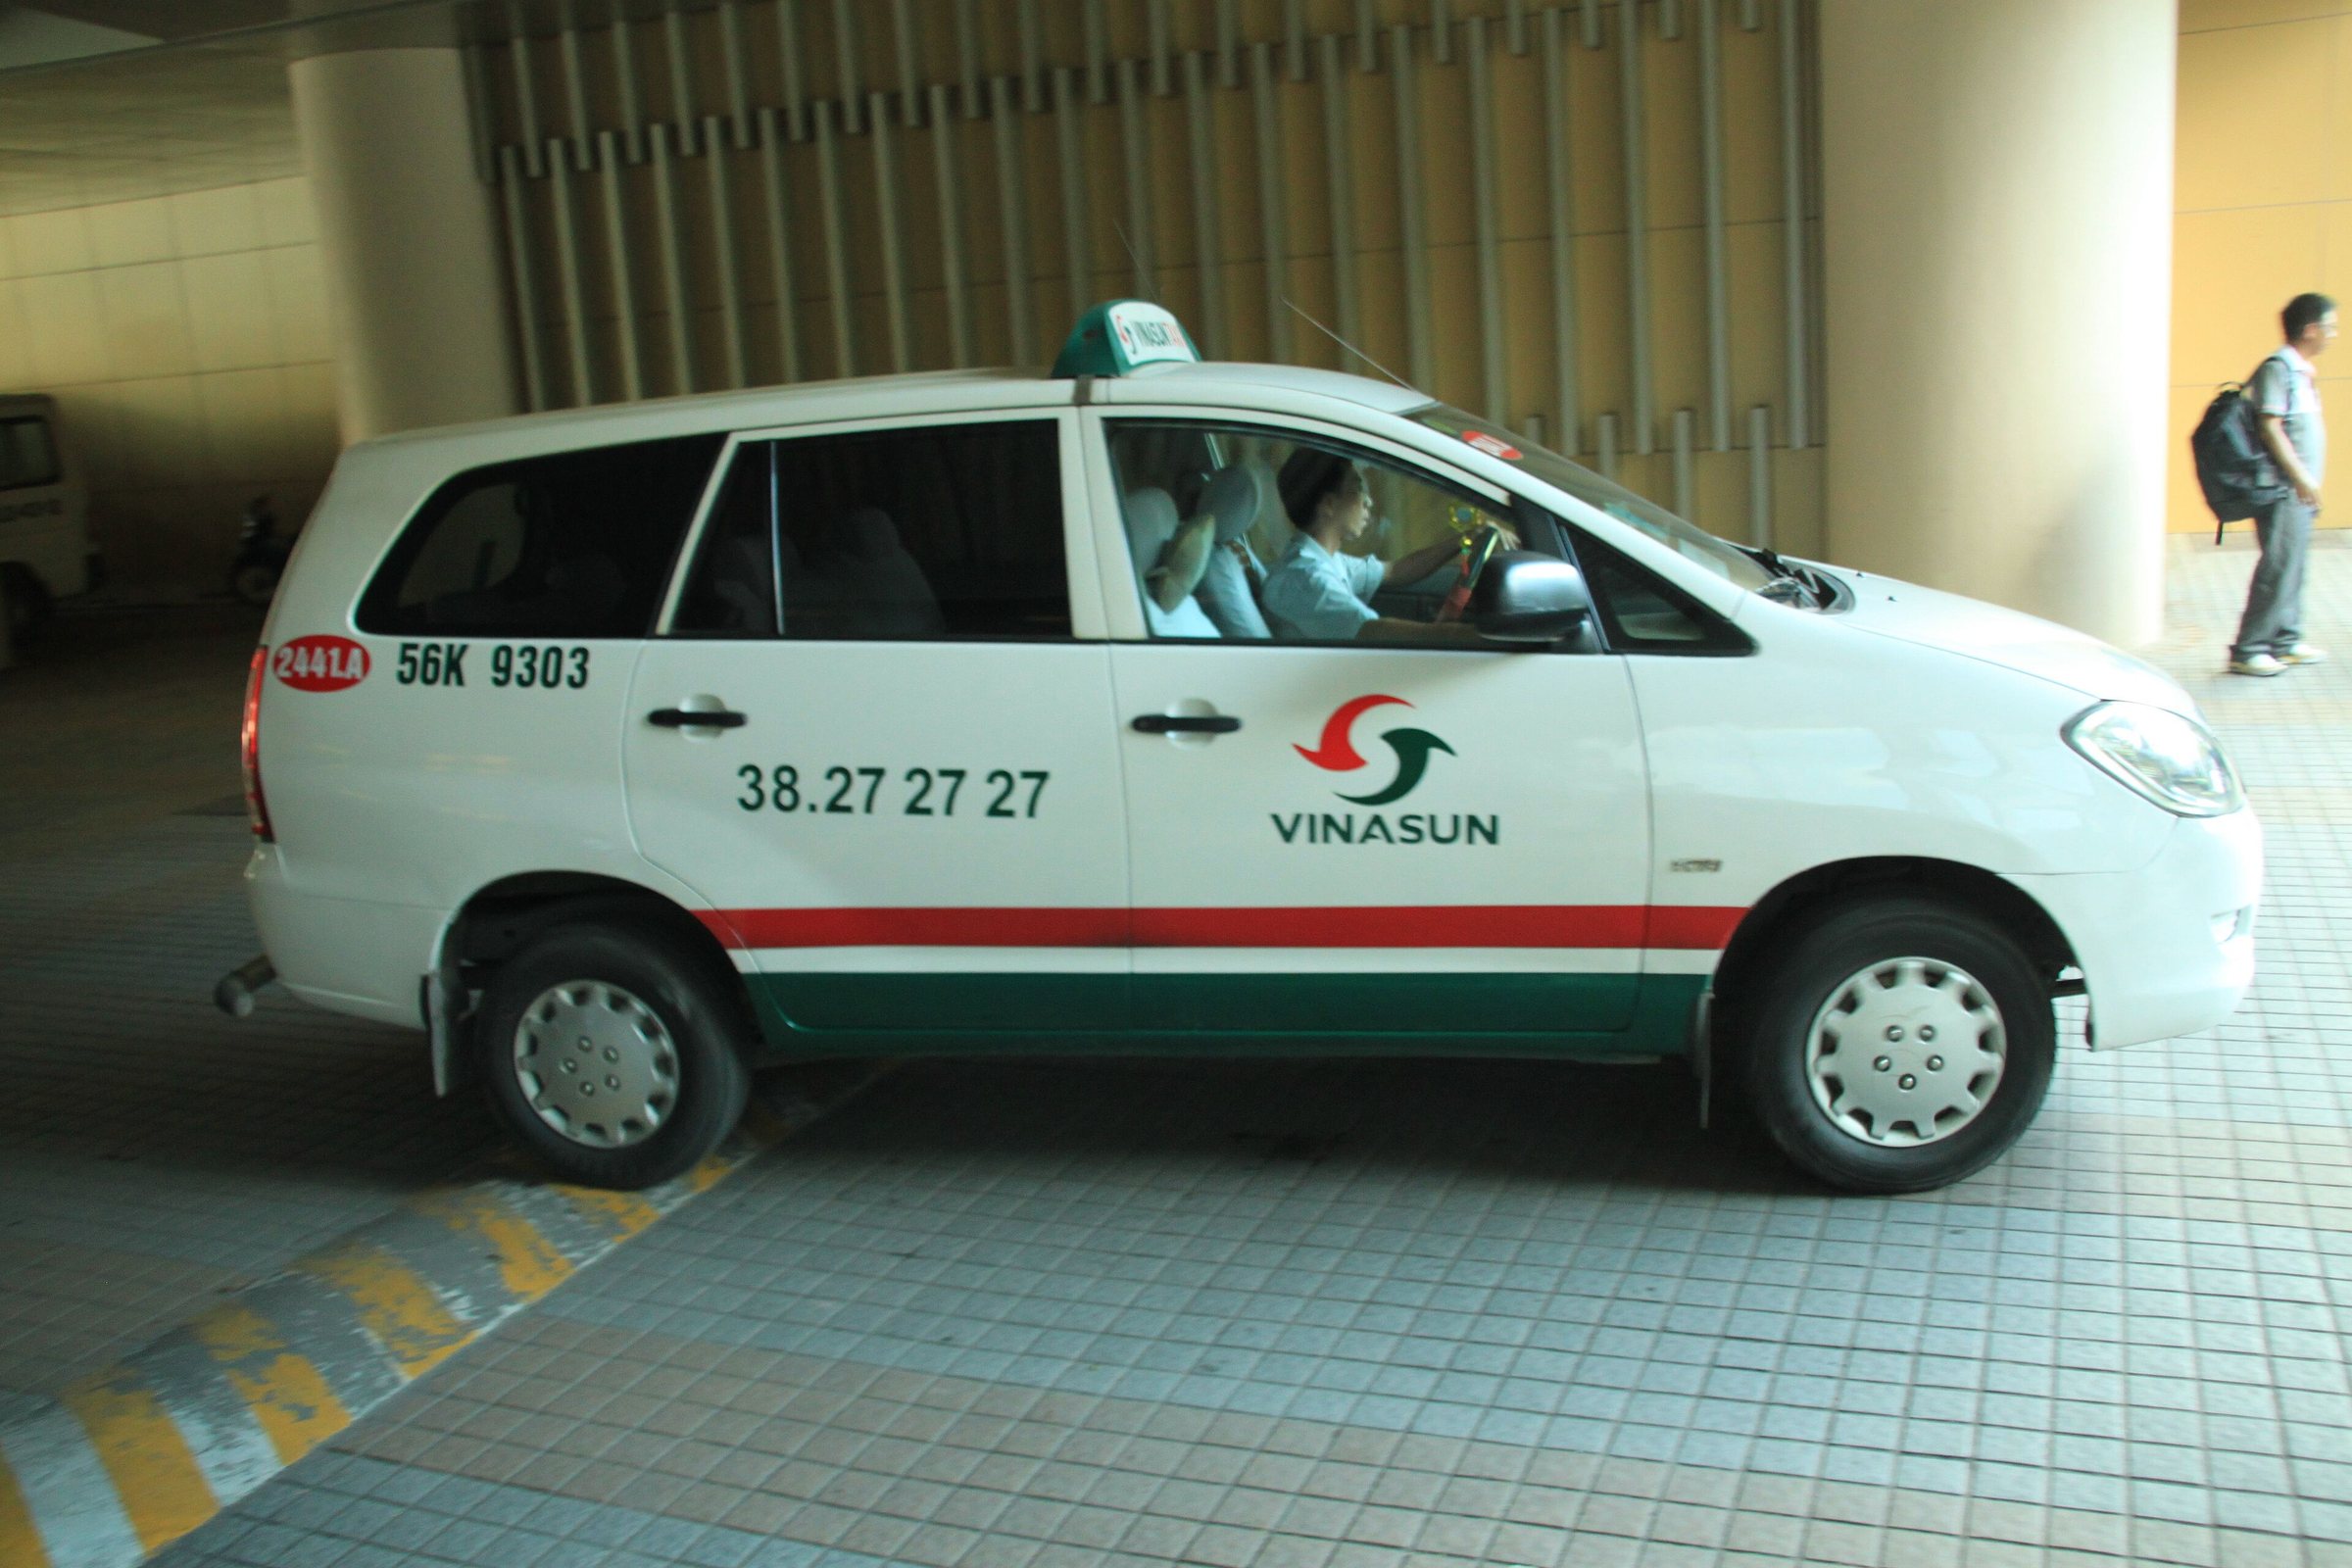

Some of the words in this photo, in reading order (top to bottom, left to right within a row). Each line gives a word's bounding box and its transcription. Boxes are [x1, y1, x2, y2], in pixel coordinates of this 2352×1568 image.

[396, 643, 468, 686] 56K
[491, 644, 590, 688] 9303
[737, 763, 886, 814] 38.27
[903, 767, 967, 816] 27
[985, 769, 1051, 818] 27
[1270, 813, 1499, 845] VINASUN
